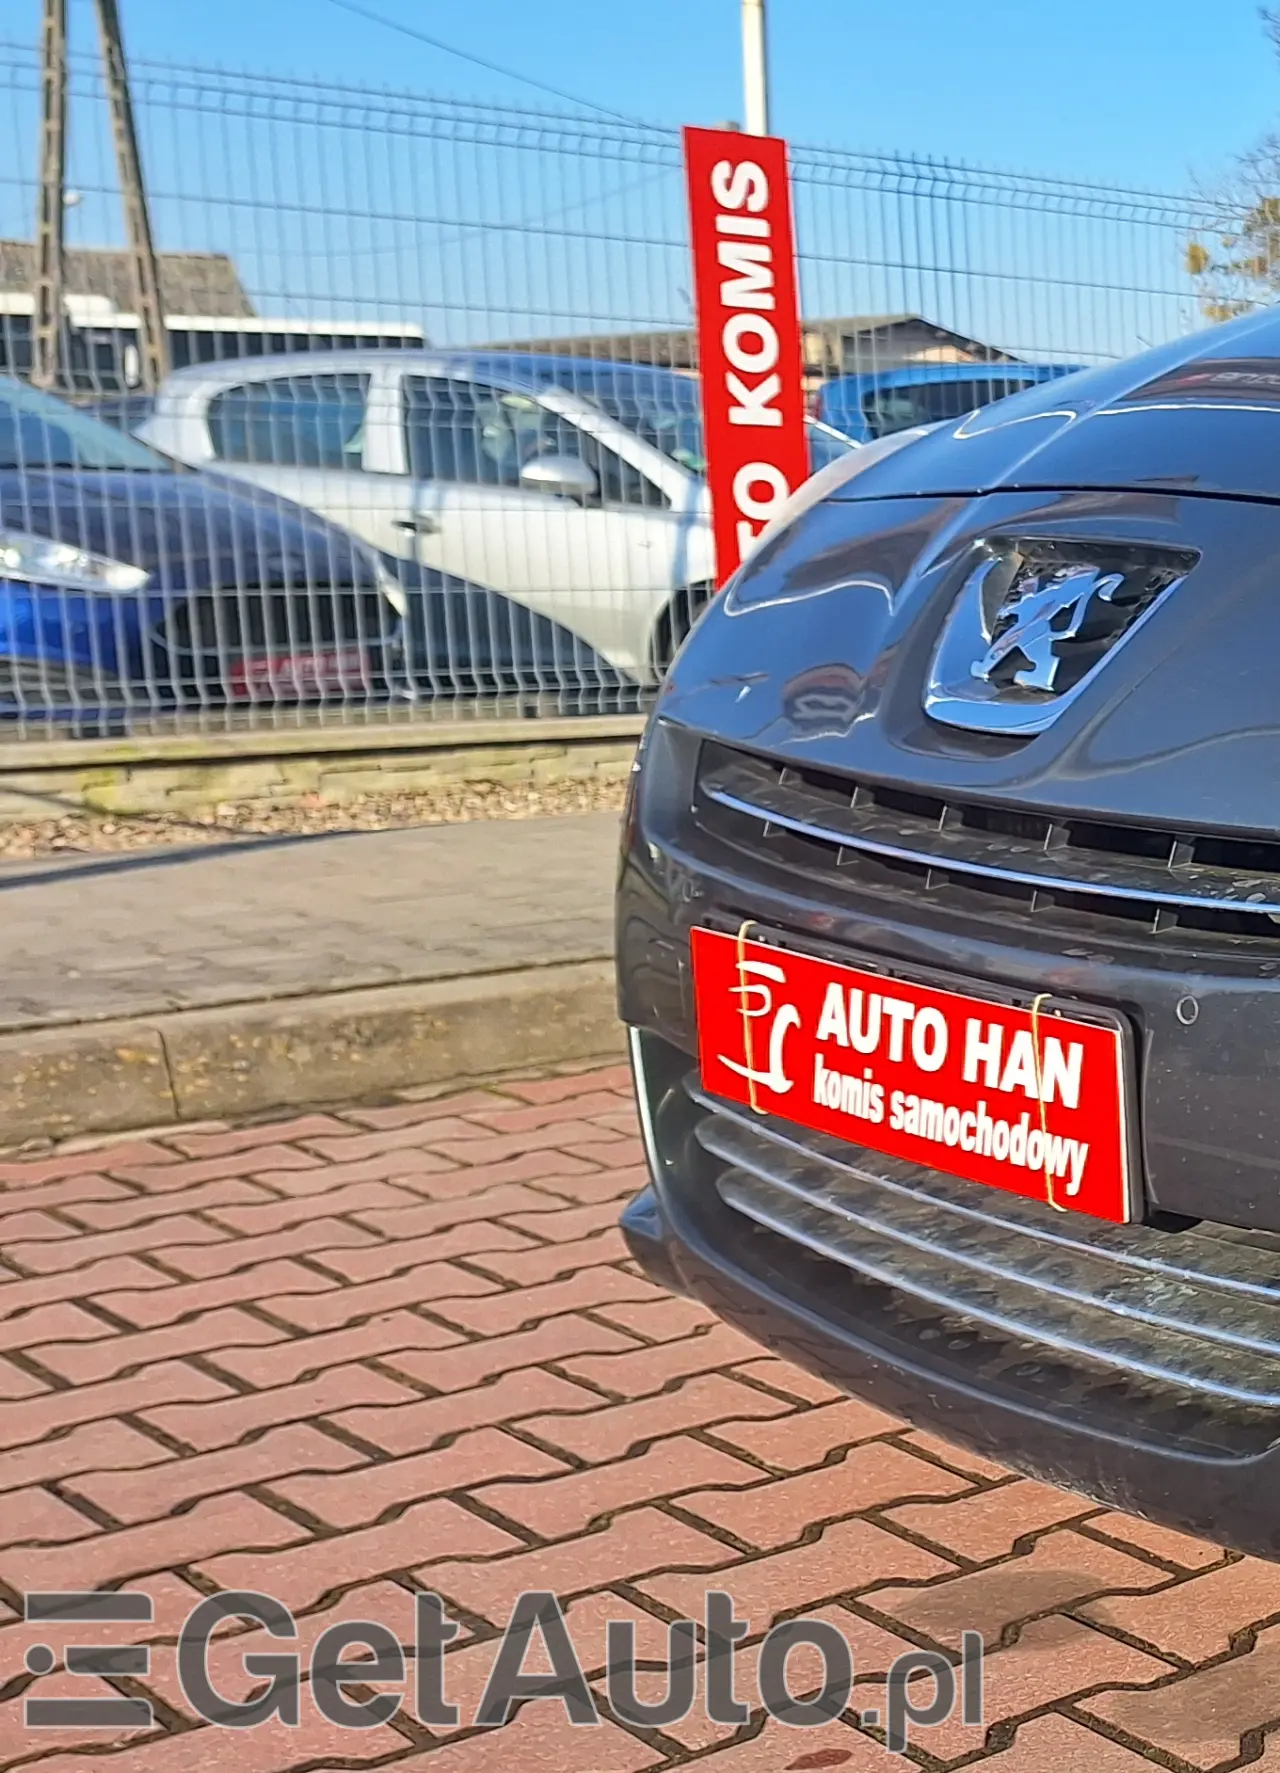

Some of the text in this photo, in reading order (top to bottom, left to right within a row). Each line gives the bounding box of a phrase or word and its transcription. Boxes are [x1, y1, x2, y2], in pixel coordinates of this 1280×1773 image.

[712, 159, 783, 427] KOMIS
[816, 982, 1084, 1109] AUTO HAN
[813, 1053, 1090, 1196] komis samochodowy
